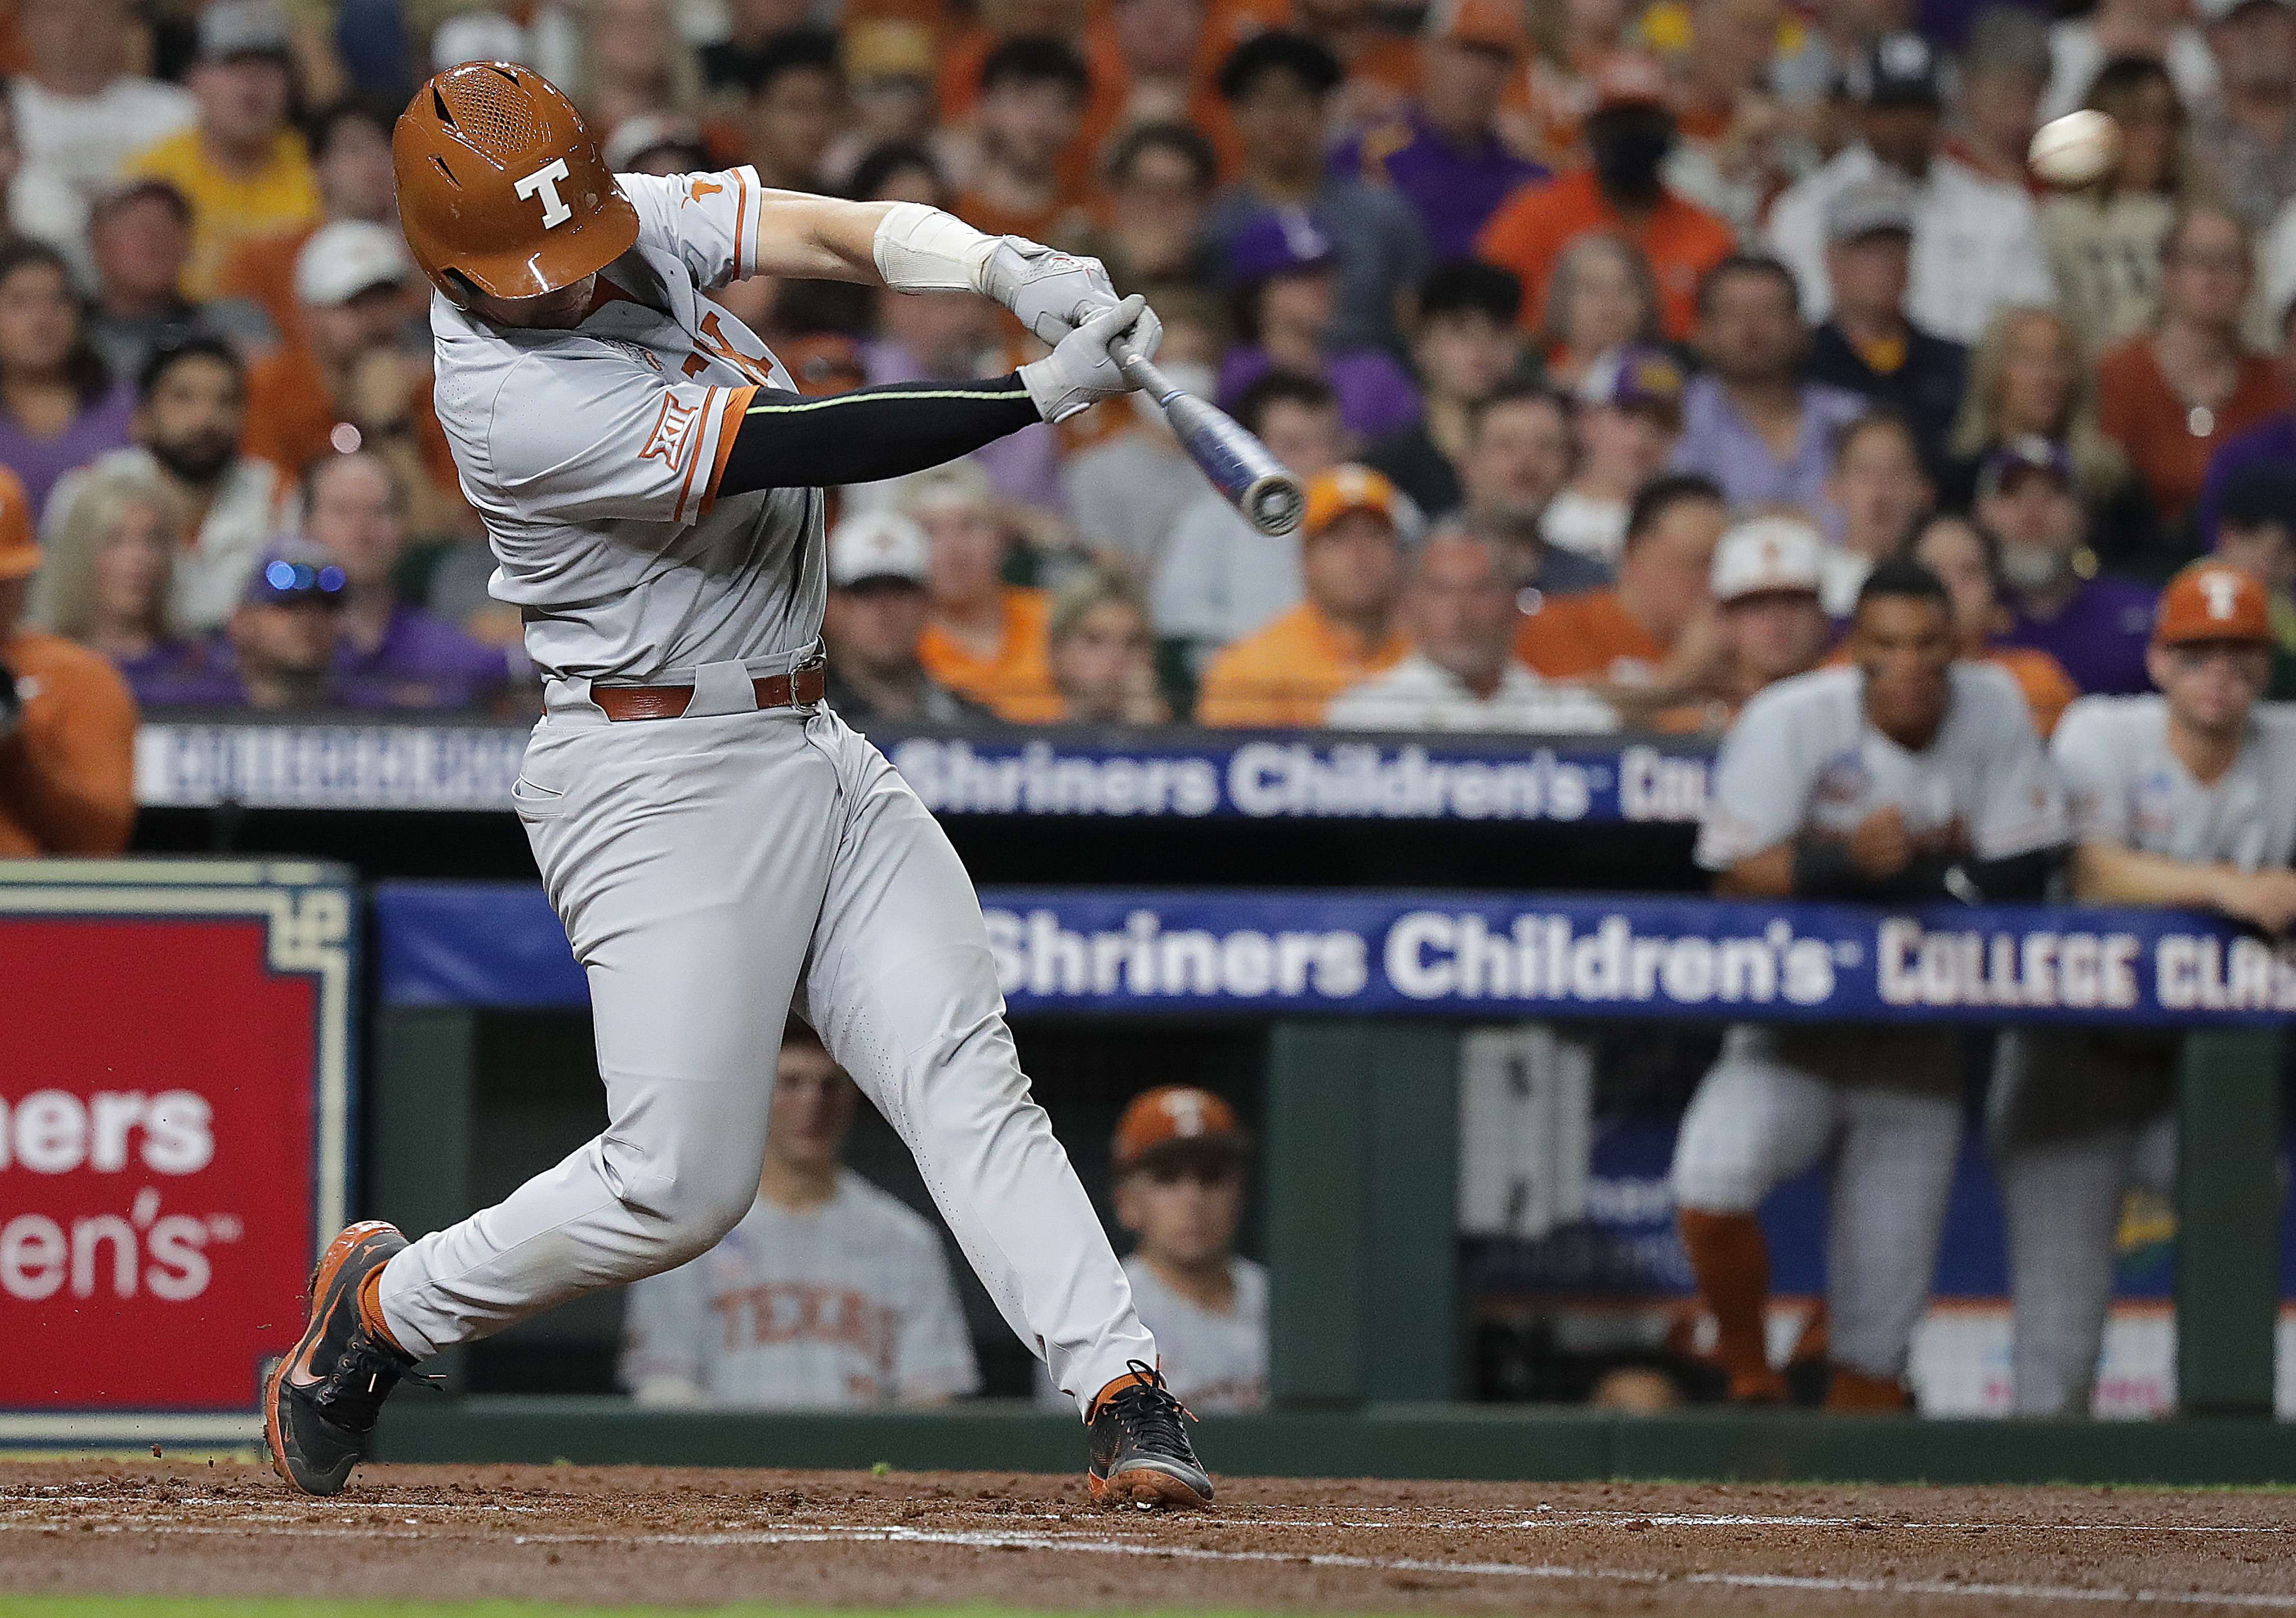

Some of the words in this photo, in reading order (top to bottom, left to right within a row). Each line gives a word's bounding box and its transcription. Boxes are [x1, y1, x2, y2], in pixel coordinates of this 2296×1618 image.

[513, 157, 572, 230] T
[982, 908, 1368, 998] Shriners
[1384, 910, 1837, 1005] Children's
[1878, 917, 2139, 1009] COLLEGE
